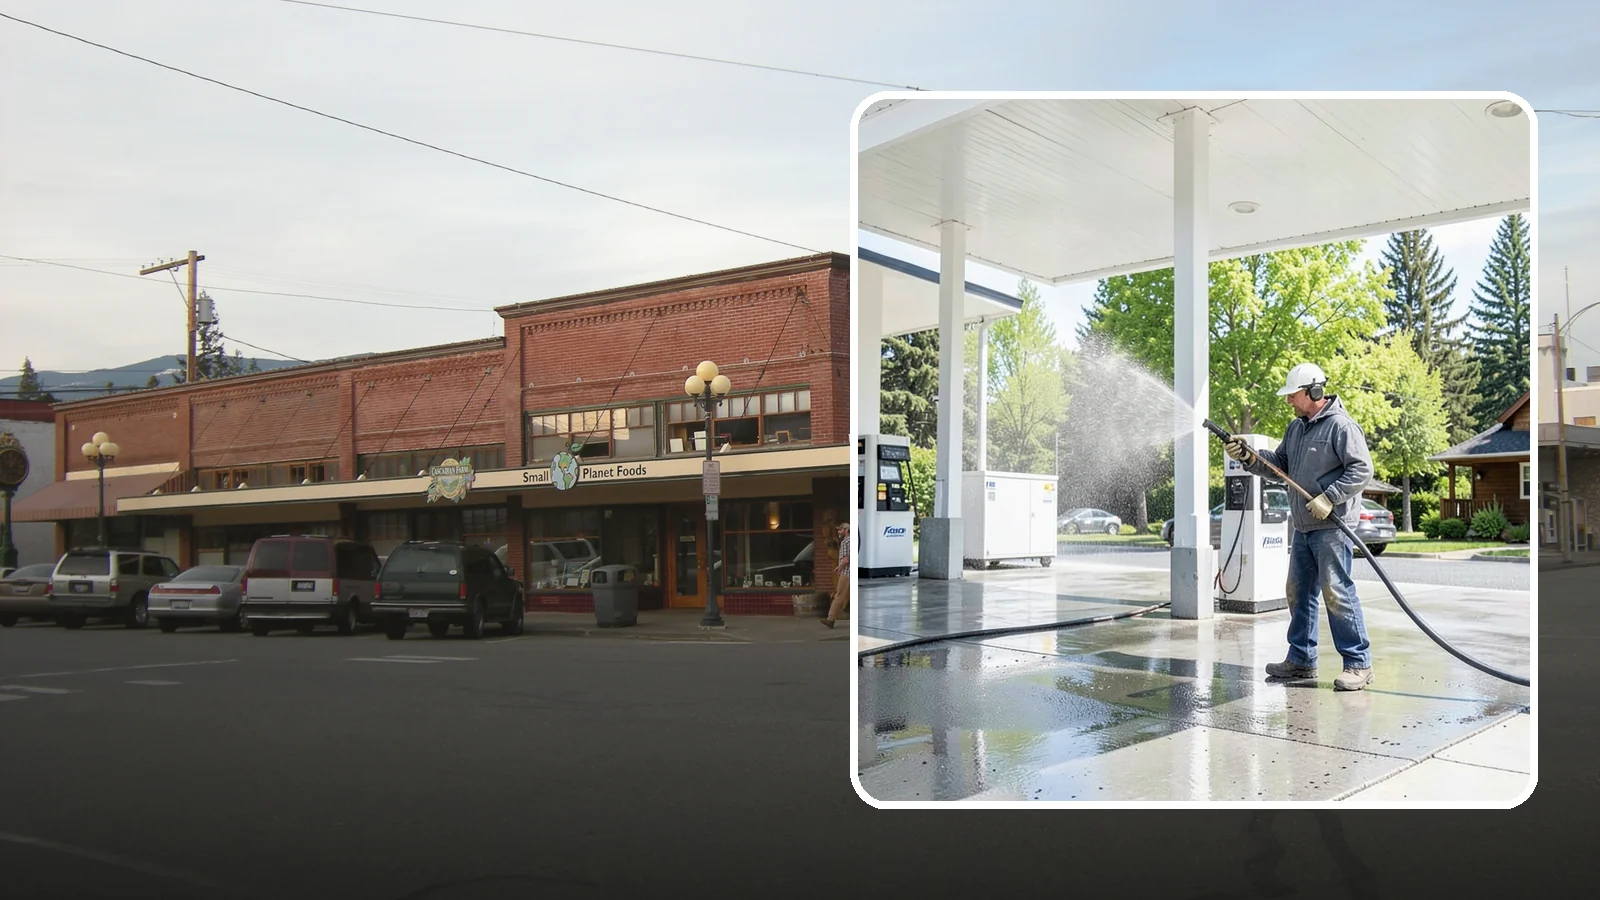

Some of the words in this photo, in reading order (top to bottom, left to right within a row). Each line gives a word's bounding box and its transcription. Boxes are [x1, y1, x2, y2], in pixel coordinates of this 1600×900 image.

[523, 471, 549, 483] Small
[582, 467, 614, 479] Planet
[617, 464, 647, 477] Foods
